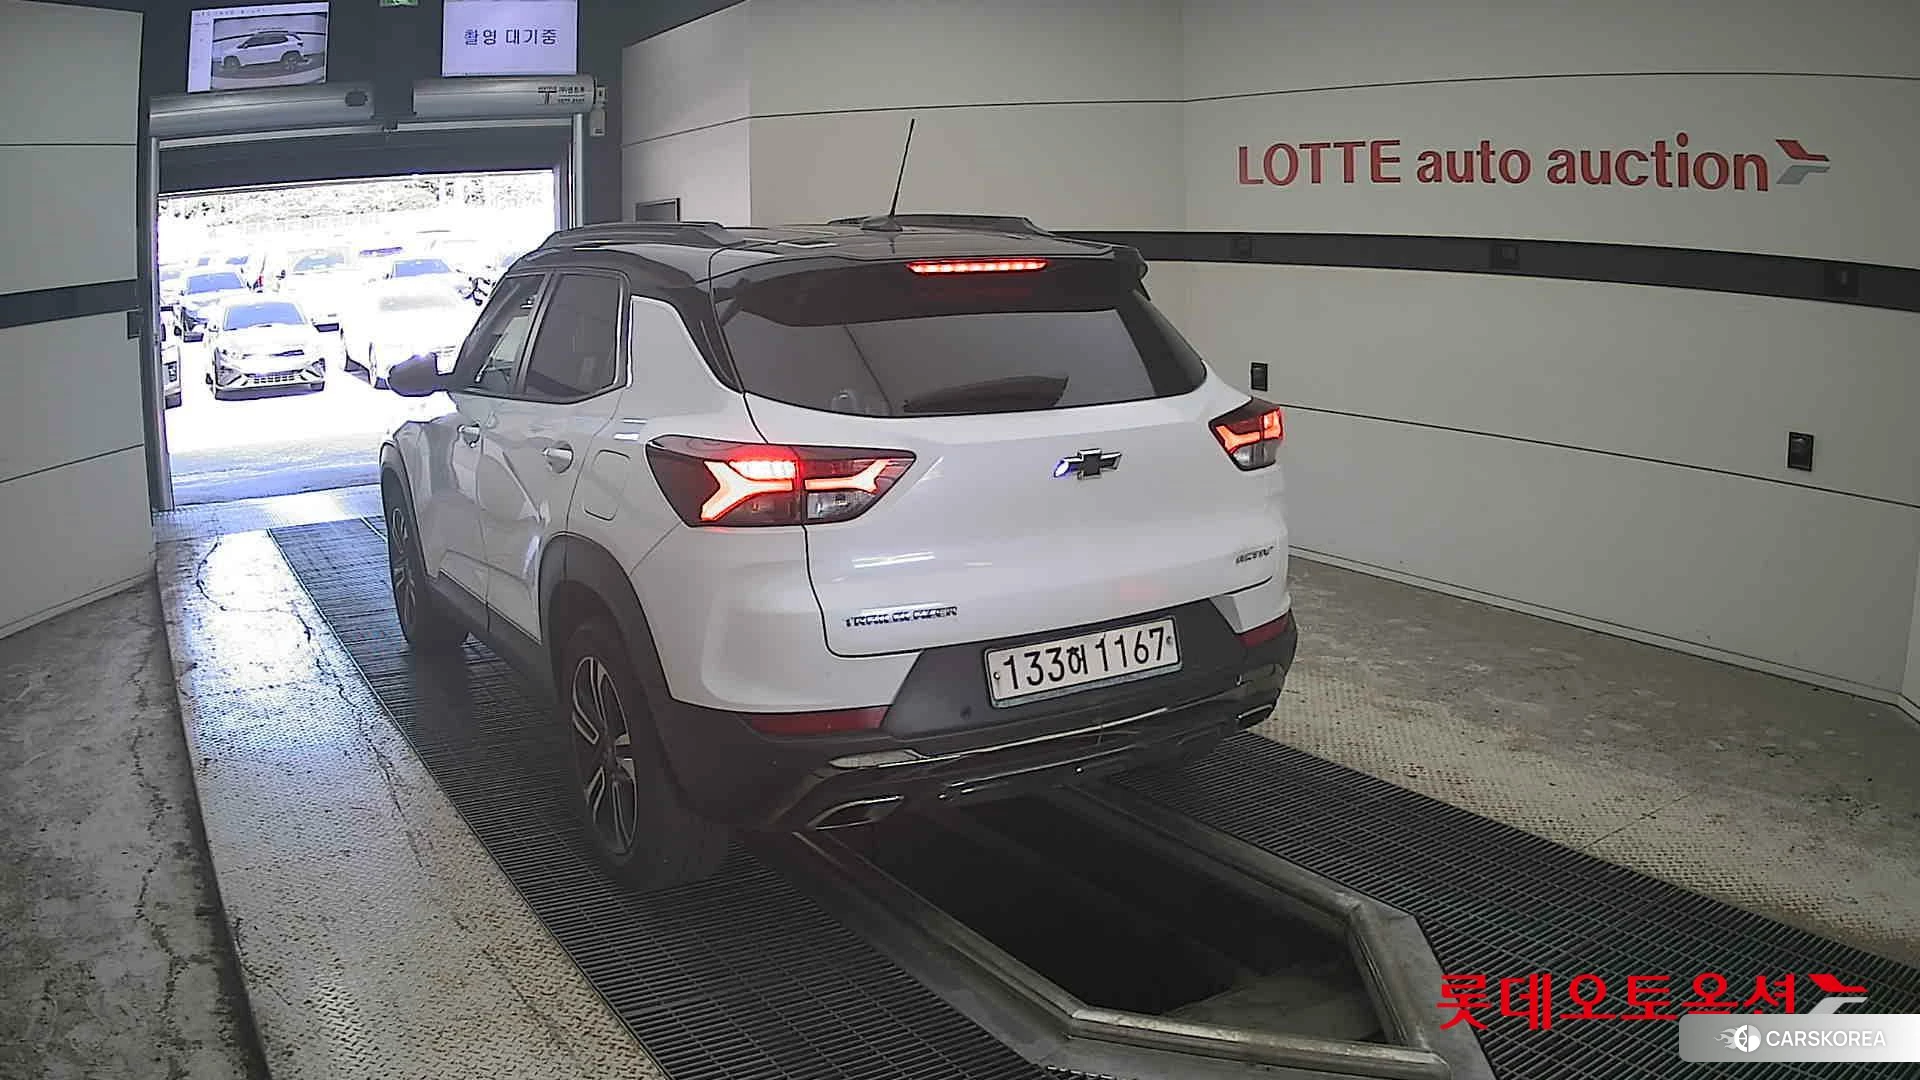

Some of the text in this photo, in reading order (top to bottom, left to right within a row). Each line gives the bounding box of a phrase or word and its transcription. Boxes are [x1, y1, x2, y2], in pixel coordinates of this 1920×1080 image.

[505, 28, 557, 46] 대기중
[1238, 132, 1769, 192] LOTTE auto auction
